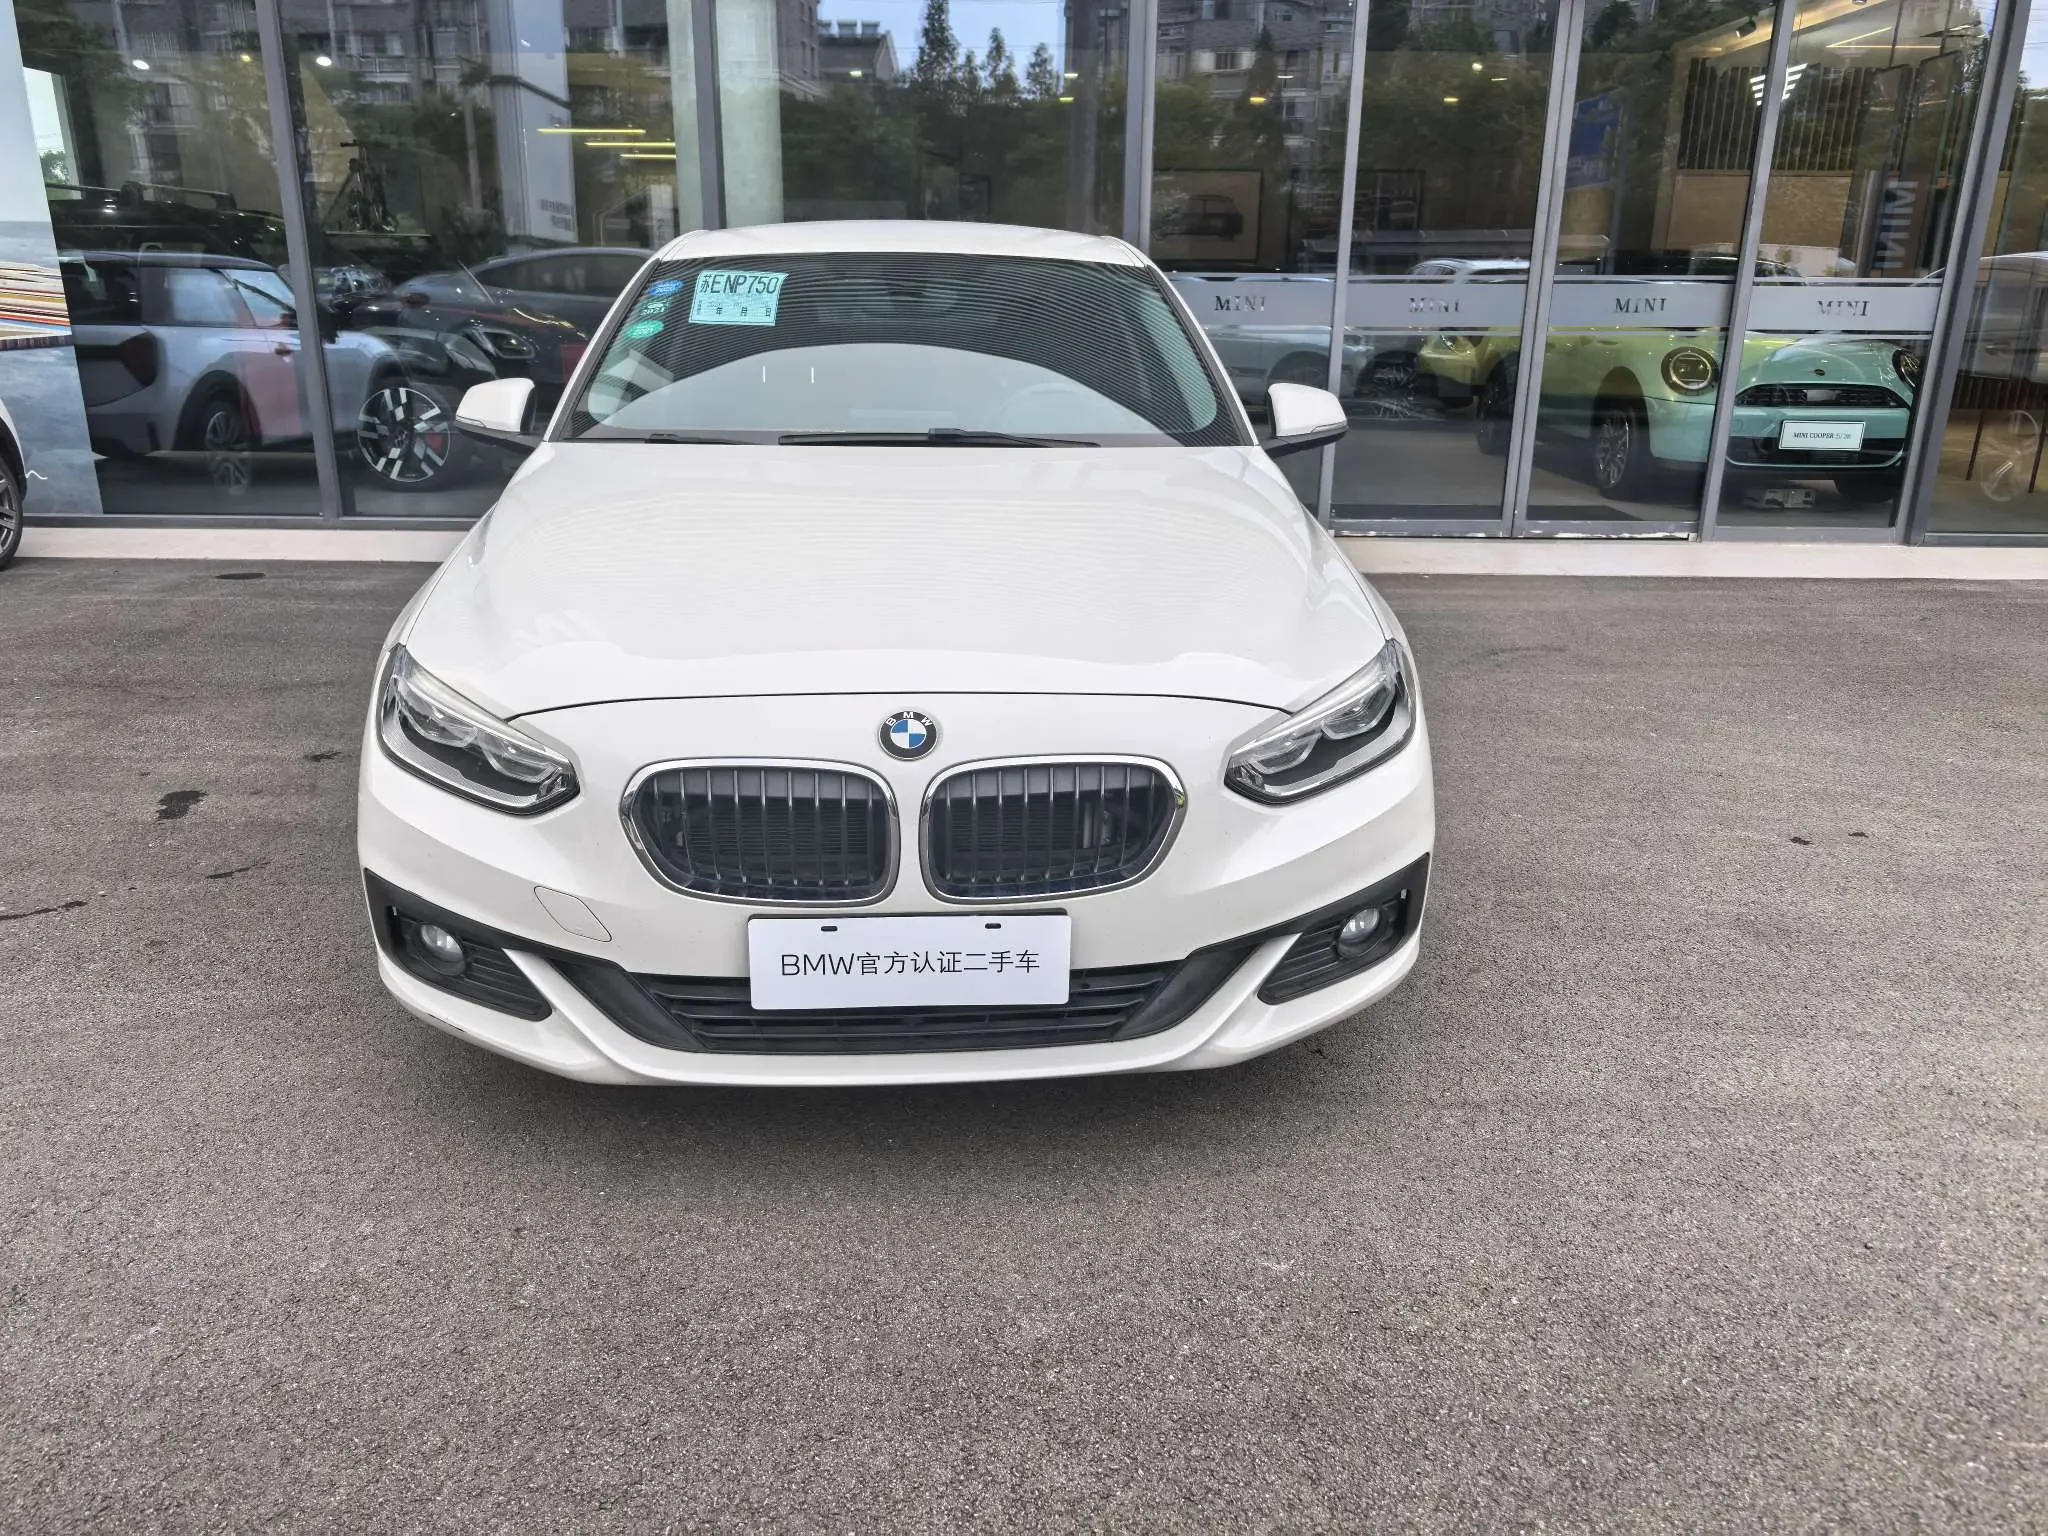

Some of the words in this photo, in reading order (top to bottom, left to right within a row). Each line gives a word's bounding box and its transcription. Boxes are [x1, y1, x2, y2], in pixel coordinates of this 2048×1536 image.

[700, 274, 779, 294] 苏ENP750
[1214, 295, 1267, 312] MINI
[1409, 297, 1460, 313] MINI
[1615, 297, 1668, 314] MINI
[1816, 299, 1870, 317] MINI
[1809, 432, 1834, 440] COOPER
[885, 711, 933, 726] BMW
[781, 950, 1040, 977] BMW官方认证二手车
